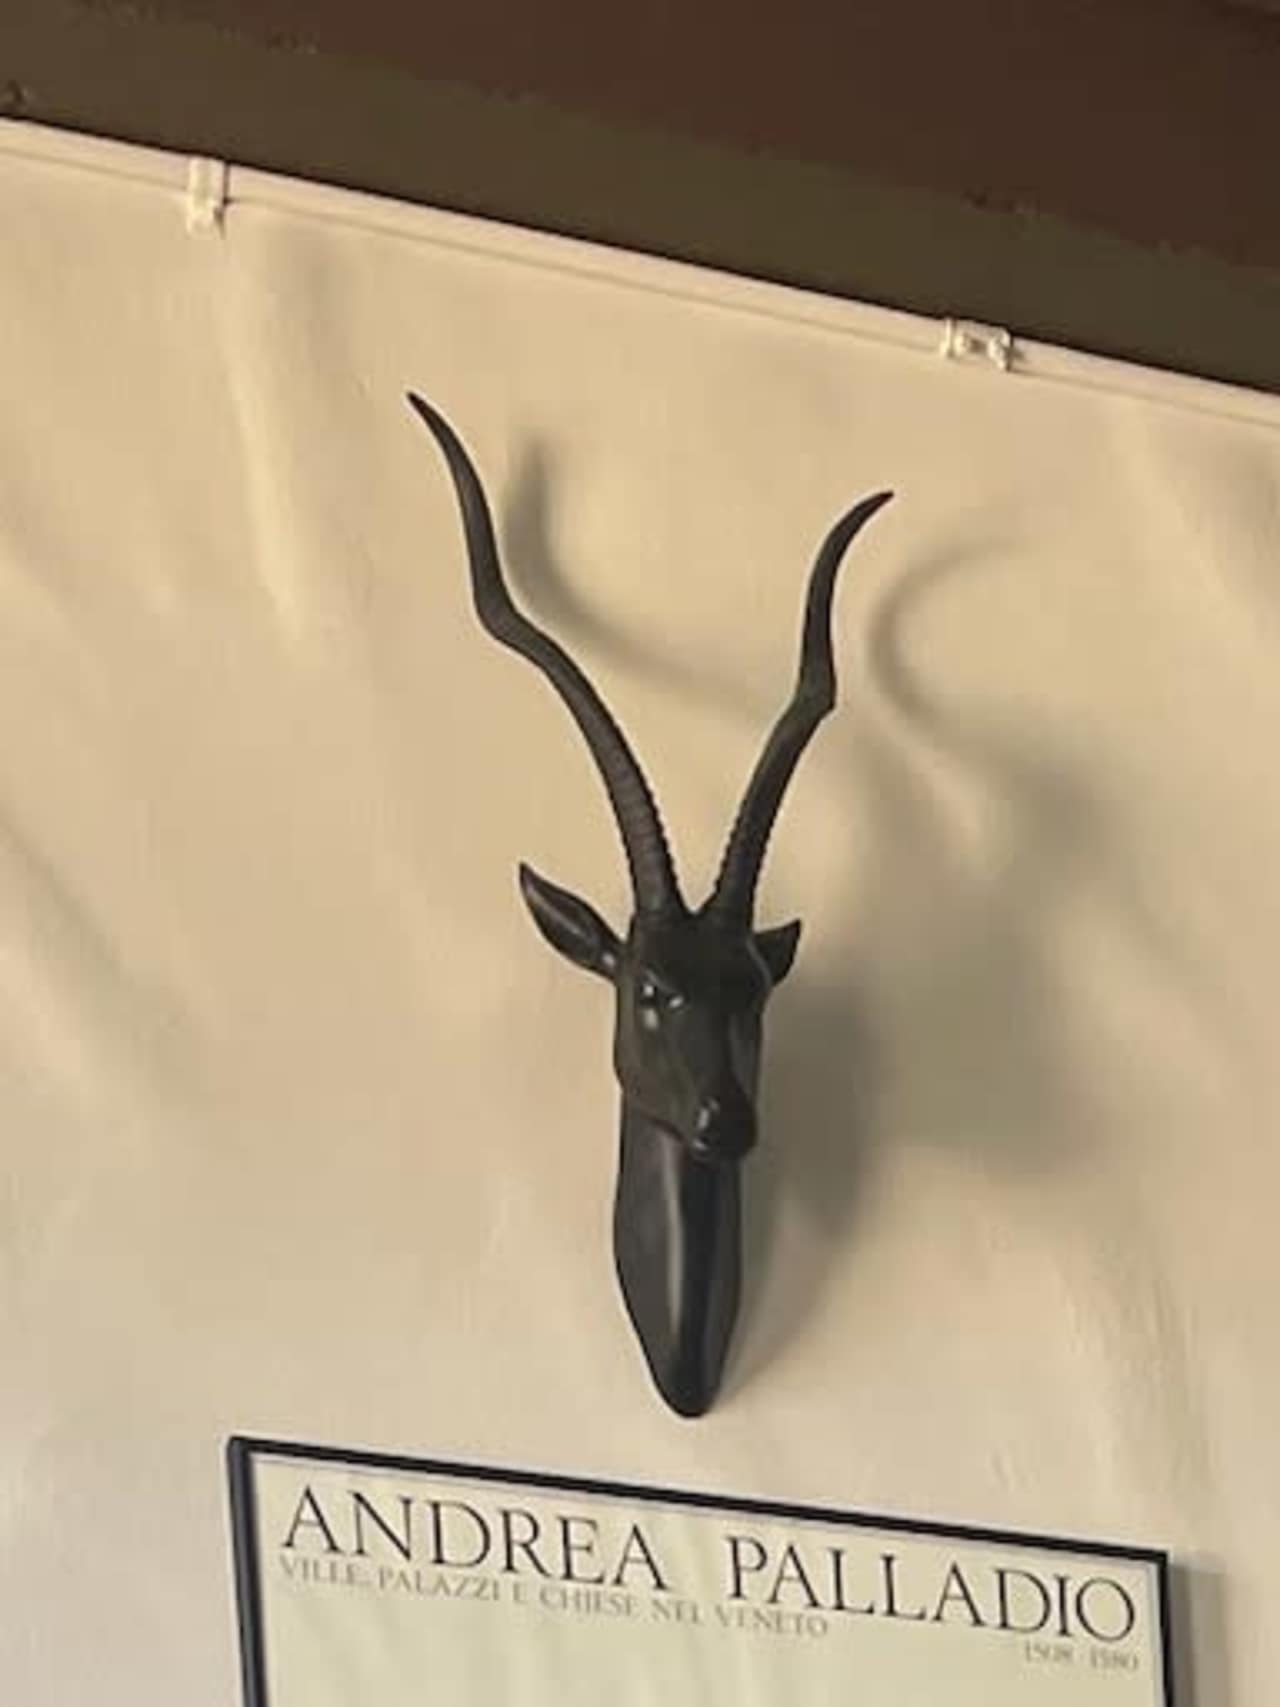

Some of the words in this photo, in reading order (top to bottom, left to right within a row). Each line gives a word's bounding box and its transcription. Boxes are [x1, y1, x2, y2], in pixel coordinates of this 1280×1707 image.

[281, 1486, 668, 1591] ANDREA
[724, 1535, 1136, 1643] PALLADIO
[378, 1567, 501, 1602] PALAZZI
[538, 1582, 636, 1617] CHIESE
[714, 1603, 830, 1638] VENETO
